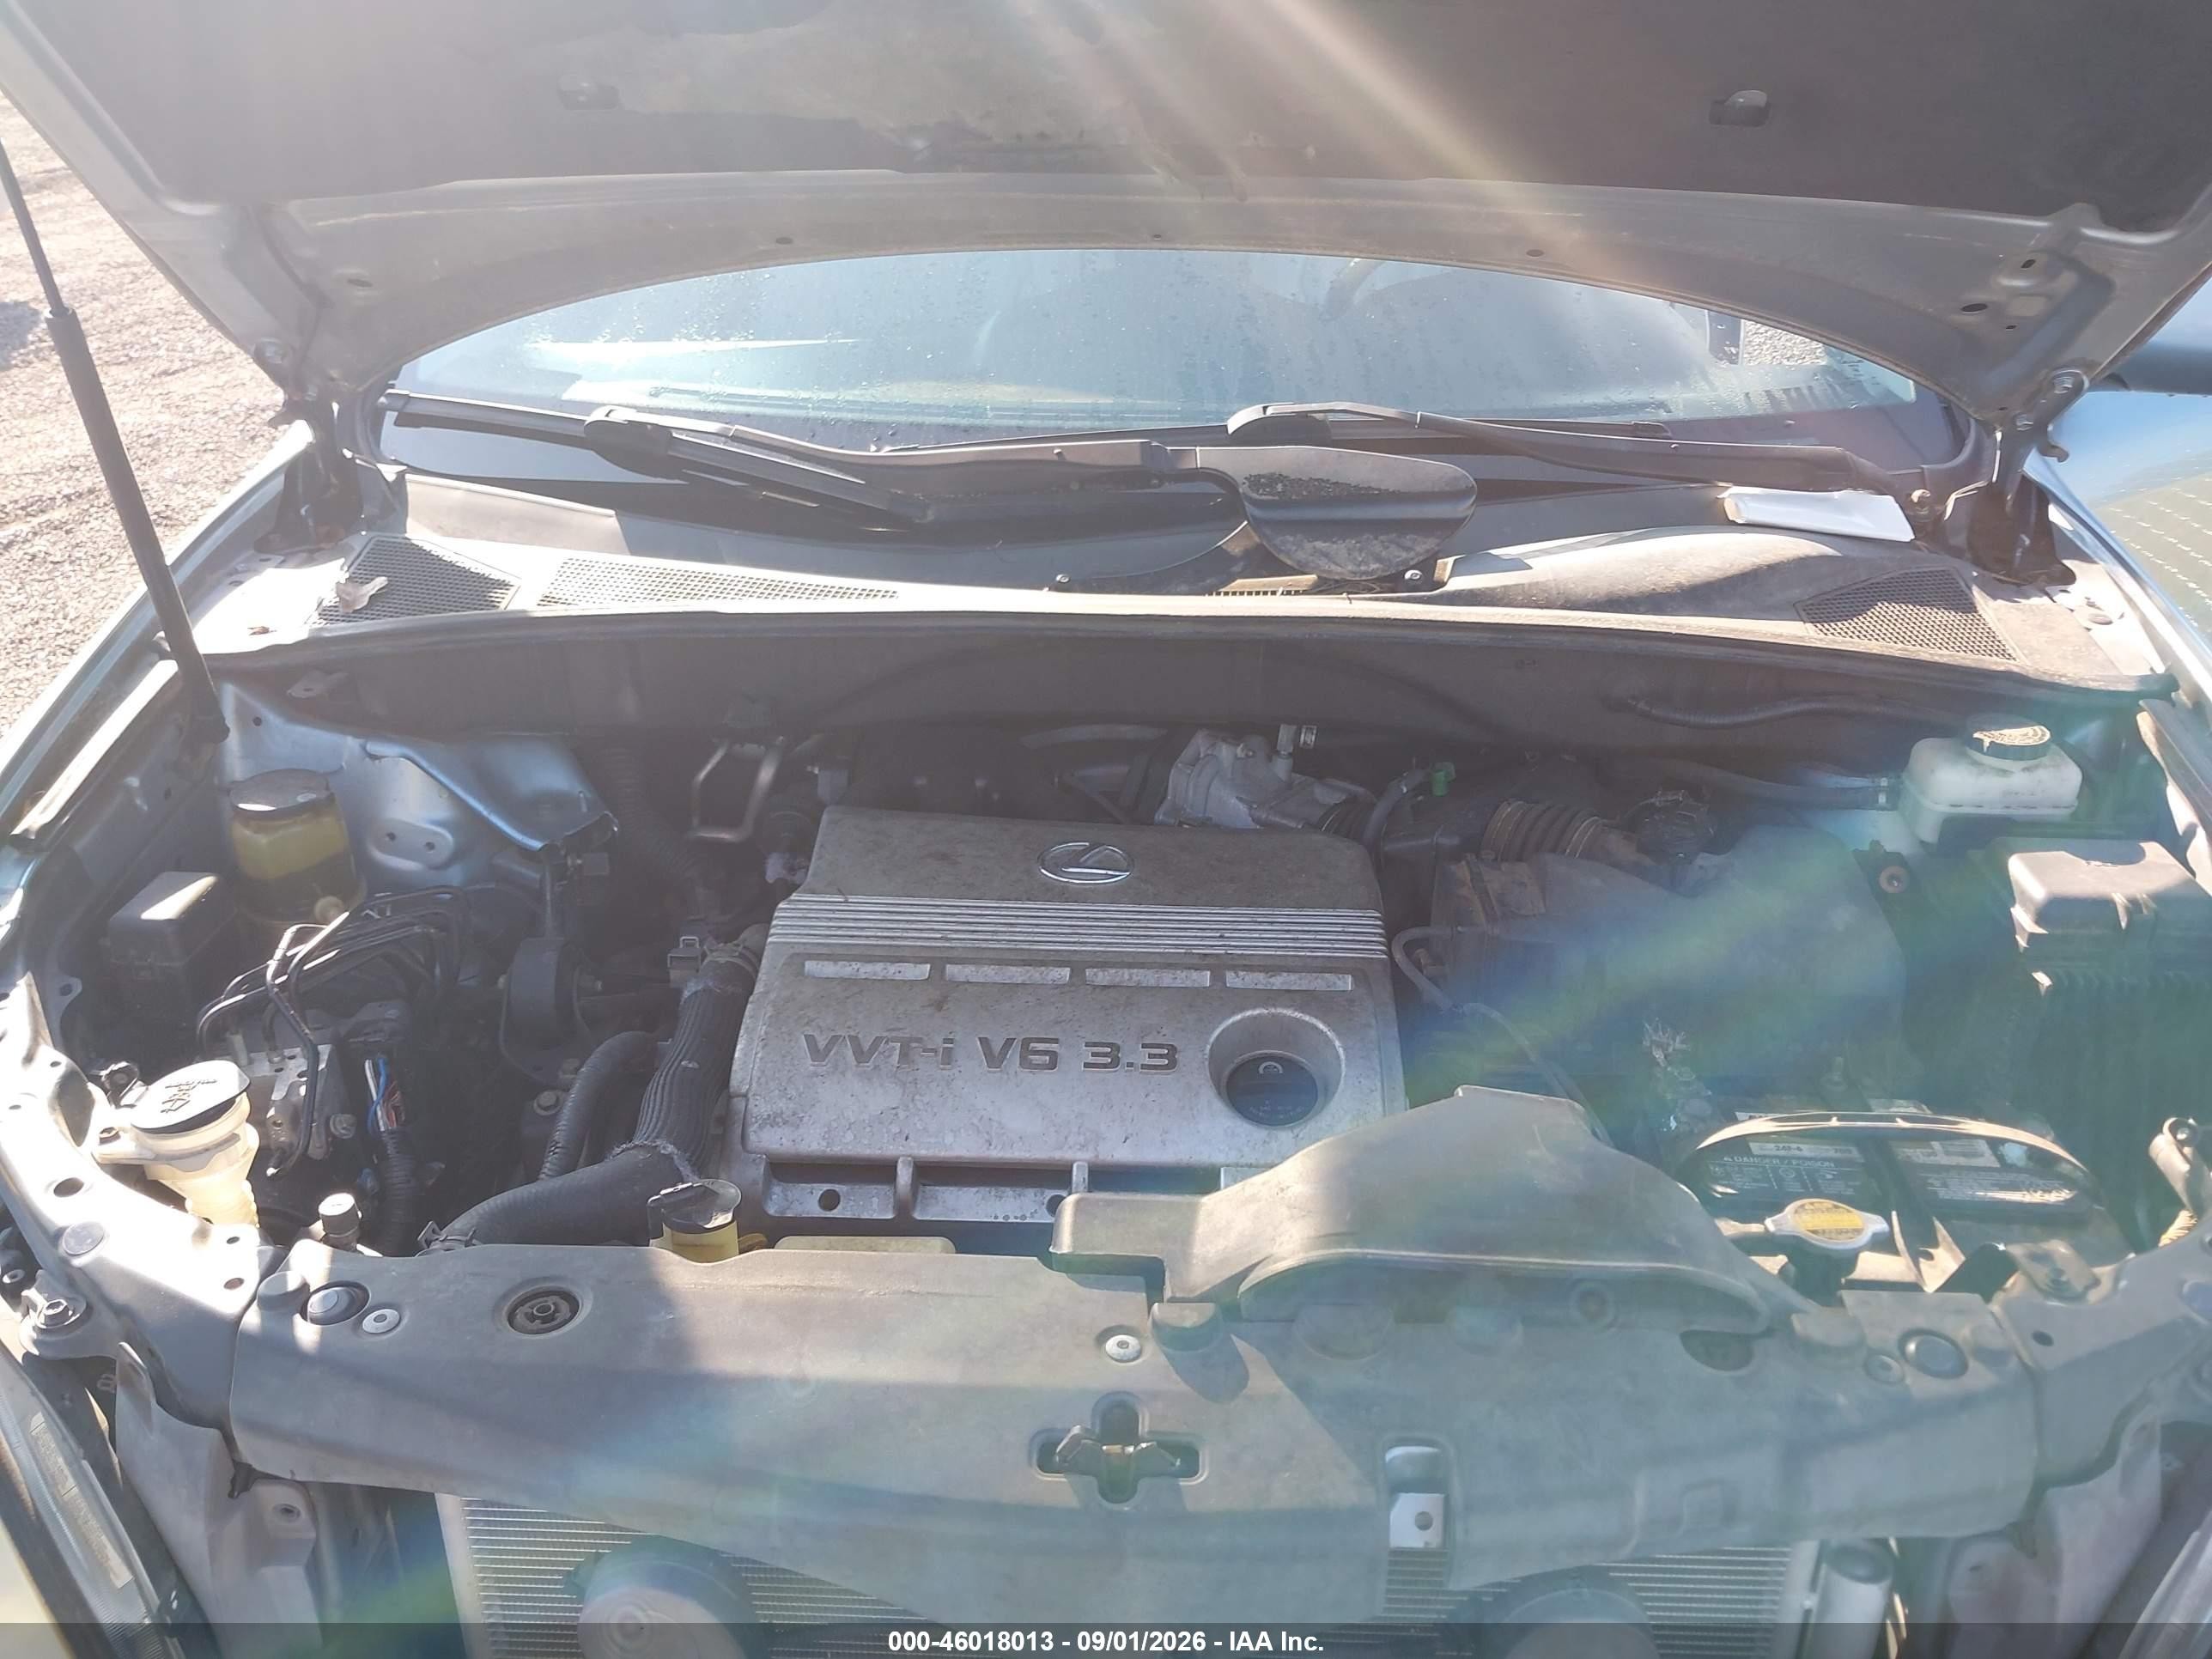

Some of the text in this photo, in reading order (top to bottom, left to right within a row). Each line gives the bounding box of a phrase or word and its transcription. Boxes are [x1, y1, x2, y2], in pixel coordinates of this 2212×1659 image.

[802, 1033, 1179, 1073] VVT-i V6 3.3
